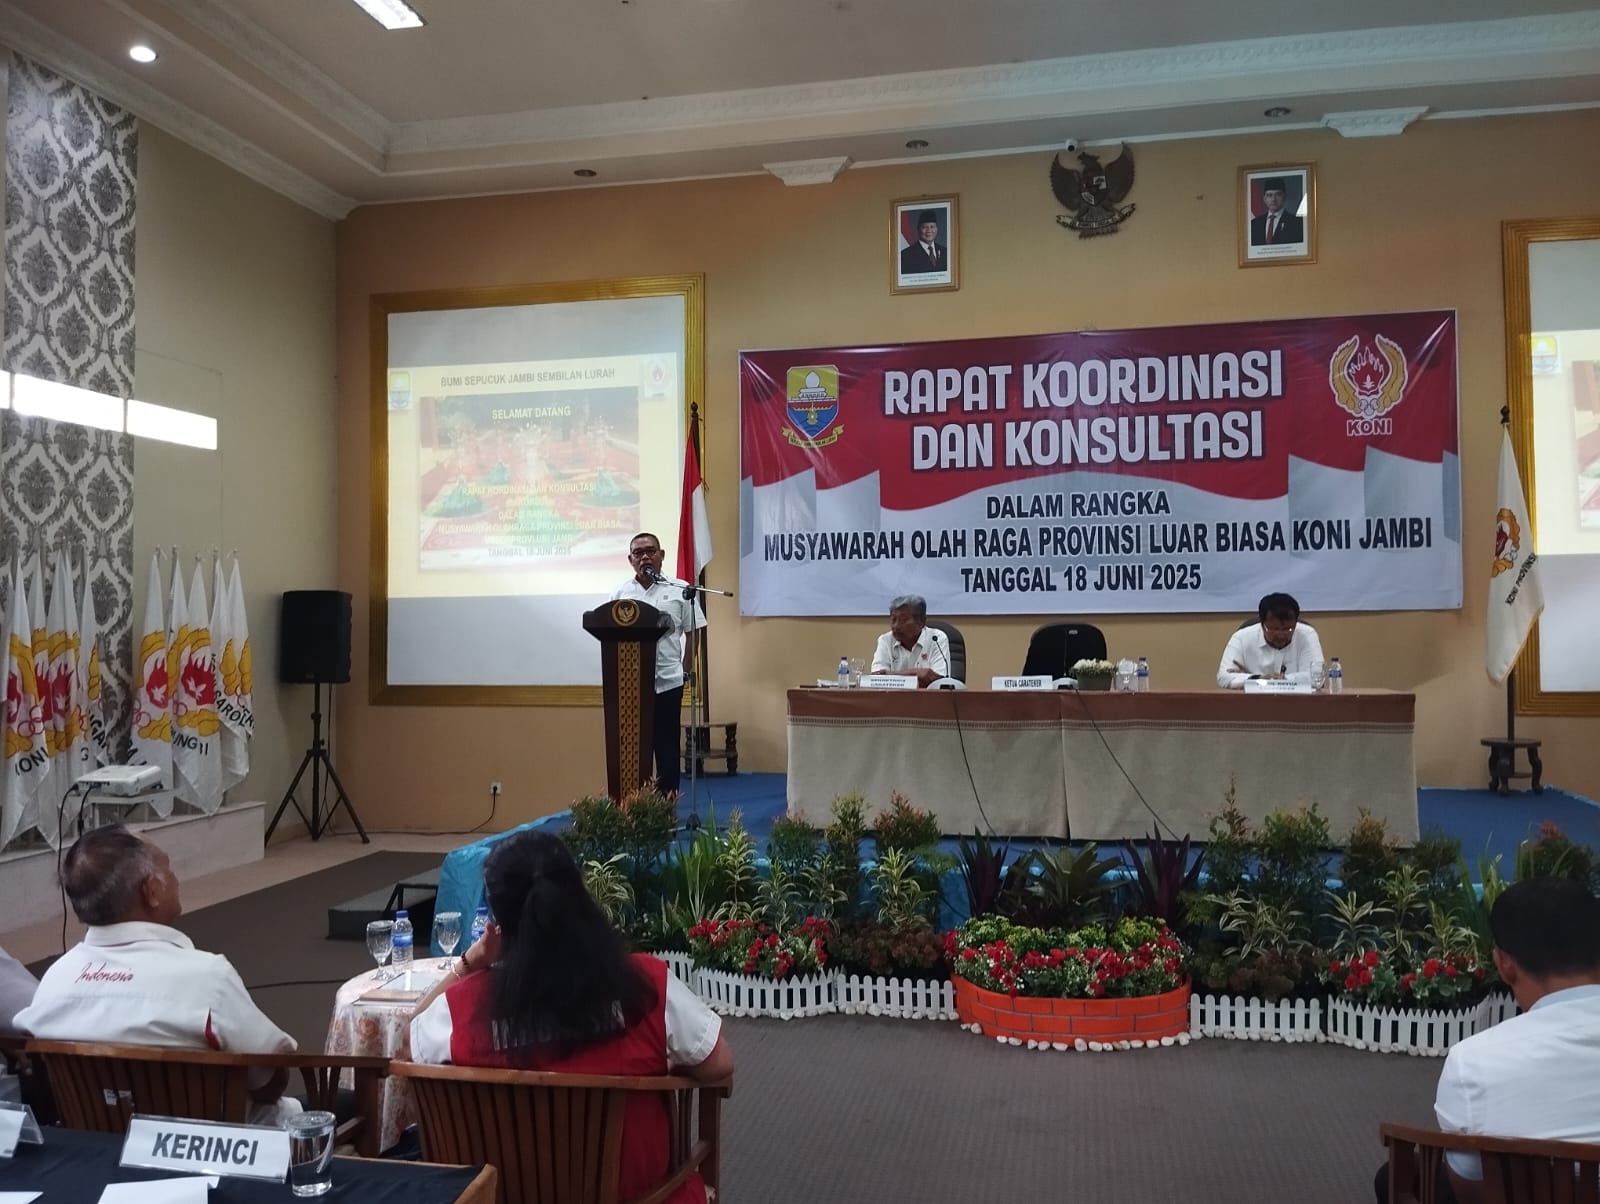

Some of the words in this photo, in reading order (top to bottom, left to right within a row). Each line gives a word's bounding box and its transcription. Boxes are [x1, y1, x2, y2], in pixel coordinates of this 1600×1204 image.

[440, 376, 463, 387] BUMI
[464, 374, 506, 386] SEPUCUK
[508, 372, 535, 384] JAMBI
[536, 370, 583, 382] SEMBILAN
[584, 368, 615, 379] LURAH
[885, 365, 1012, 415] RAPAT
[1023, 350, 1282, 408] KOORDINASI
[492, 408, 533, 420] SELAMAT
[535, 405, 571, 417] DATANG
[1346, 418, 1392, 436] KONI
[913, 422, 993, 470] DAN
[1005, 411, 1262, 467] KONSULTASI
[986, 494, 1063, 519] DALAM
[1071, 491, 1171, 517] RANGKA
[764, 531, 904, 561] MUSYAWARAH
[911, 529, 967, 559] OLAH
[975, 528, 1033, 557] RAGA
[1039, 525, 1141, 556] PROVINSI
[1150, 523, 1208, 554] LUAR
[1216, 521, 1286, 552] BIASA
[1293, 519, 1351, 551] KONI
[1359, 517, 1432, 549] JAMBI
[961, 567, 1057, 593] TANGGAL
[1064, 565, 1087, 591] 18
[1094, 565, 1144, 591] JUNI
[1151, 563, 1202, 590] 2025
[75, 961, 134, 984] Indonesia
[152, 1132, 259, 1166] KERINCI
